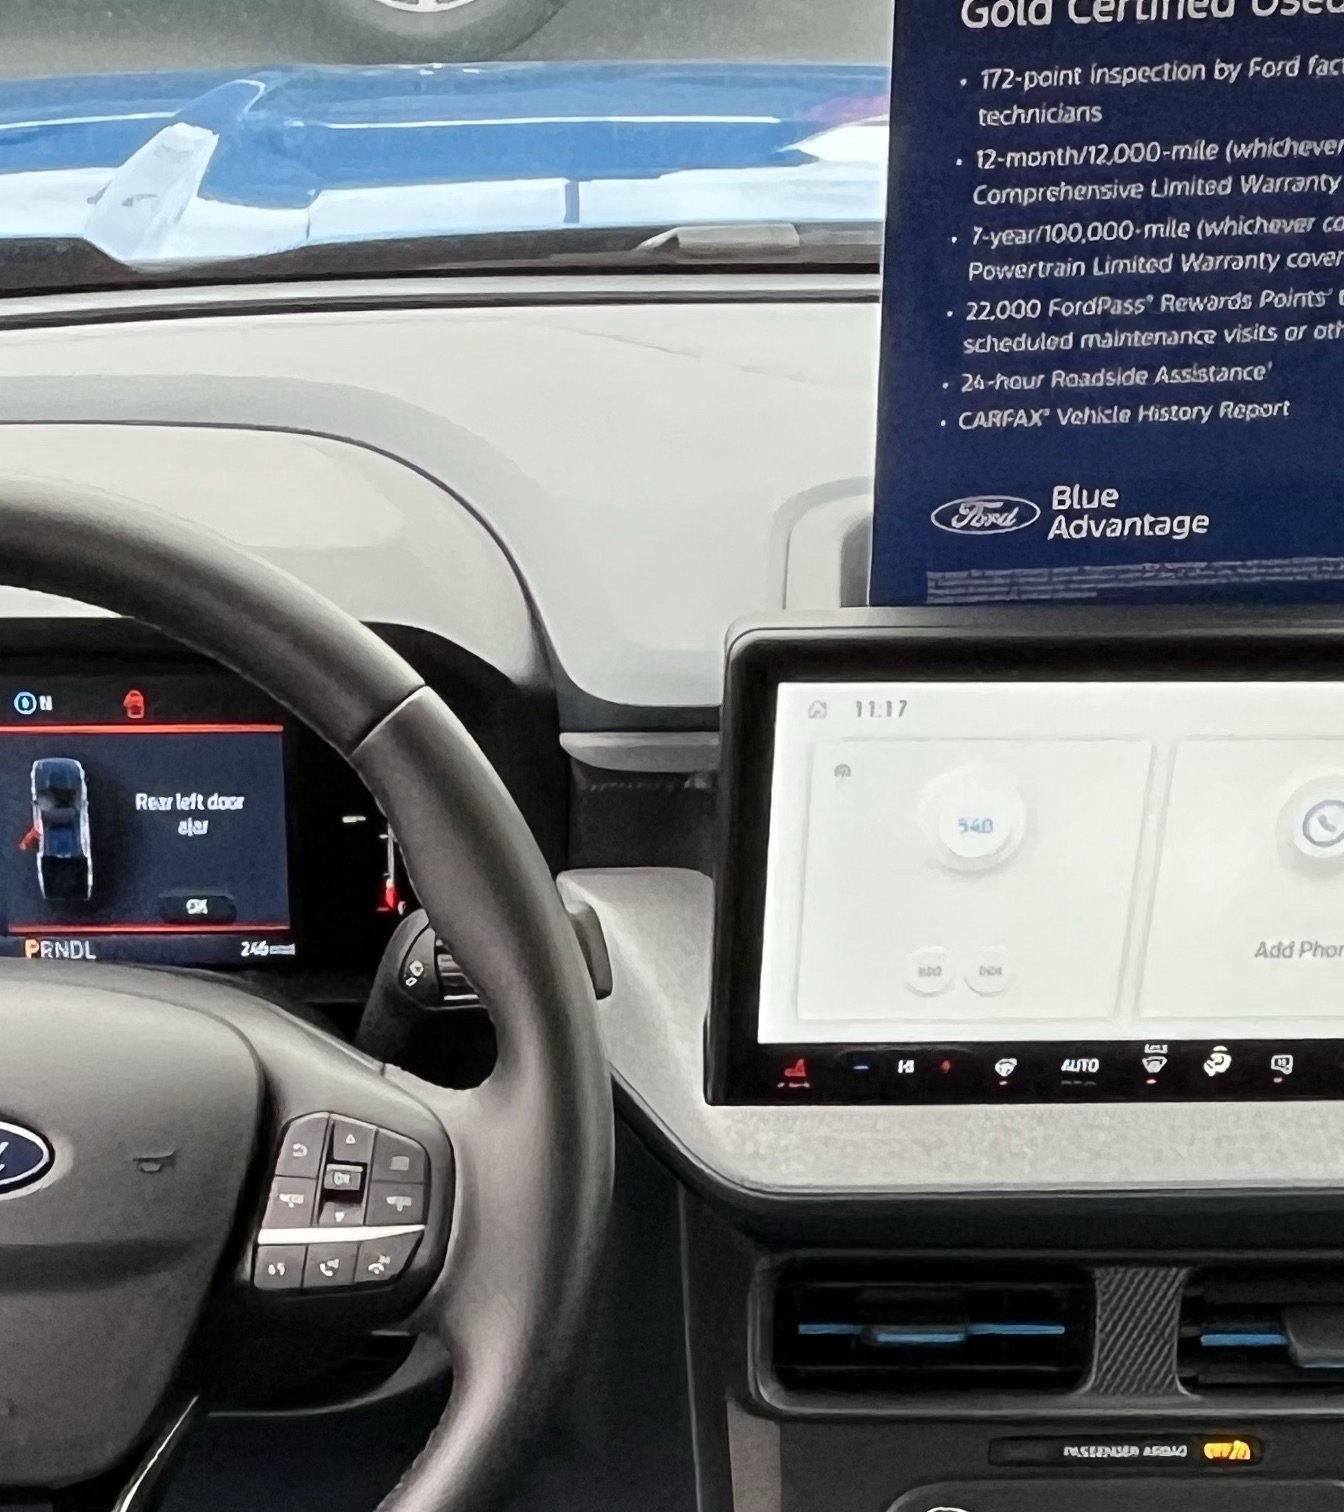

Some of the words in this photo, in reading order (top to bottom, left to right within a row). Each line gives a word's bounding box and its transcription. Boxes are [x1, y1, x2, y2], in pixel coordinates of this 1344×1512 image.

[960, 0, 1053, 28] Gold
[981, 66, 1082, 94] 172-point
[1090, 60, 1206, 87] inspection
[1214, 58, 1242, 83] by
[1248, 55, 1301, 78] Ford
[979, 103, 1103, 126] technicians
[976, 140, 1218, 169] 12-month/12,000-mile
[973, 179, 1144, 207] Comprehensive
[1151, 175, 1232, 198] Limited
[1241, 174, 1343, 195] Warranty
[972, 217, 1190, 249] 7-year/100,000-mile
[1197, 215, 1316, 239] (whichever
[968, 257, 1086, 282] Powertrain
[1093, 253, 1172, 277] Limited
[1181, 251, 1280, 273] Warranty
[966, 298, 1042, 321] 22,000
[1161, 291, 1252, 313] Rewards
[963, 331, 1074, 354] scheduled
[1080, 327, 1218, 350] maintenance
[1224, 322, 1278, 344] visits
[1284, 324, 1308, 342] or
[960, 372, 1045, 393] 24-hour
[1050, 366, 1149, 389] Roadside
[1056, 404, 1132, 426] Vehicle
[1138, 402, 1213, 425] History
[1219, 400, 1290, 422] Report
[1052, 484, 1119, 510] Blue
[1047, 513, 1210, 540] Advantage
[856, 700, 907, 718] 11:17
[135, 793, 173, 811] Rear
[175, 792, 205, 811] left
[207, 793, 245, 810] door
[178, 817, 209, 837] ajar
[1254, 941, 1295, 958] Add
[1061, 1058, 1099, 1072] AUTO
